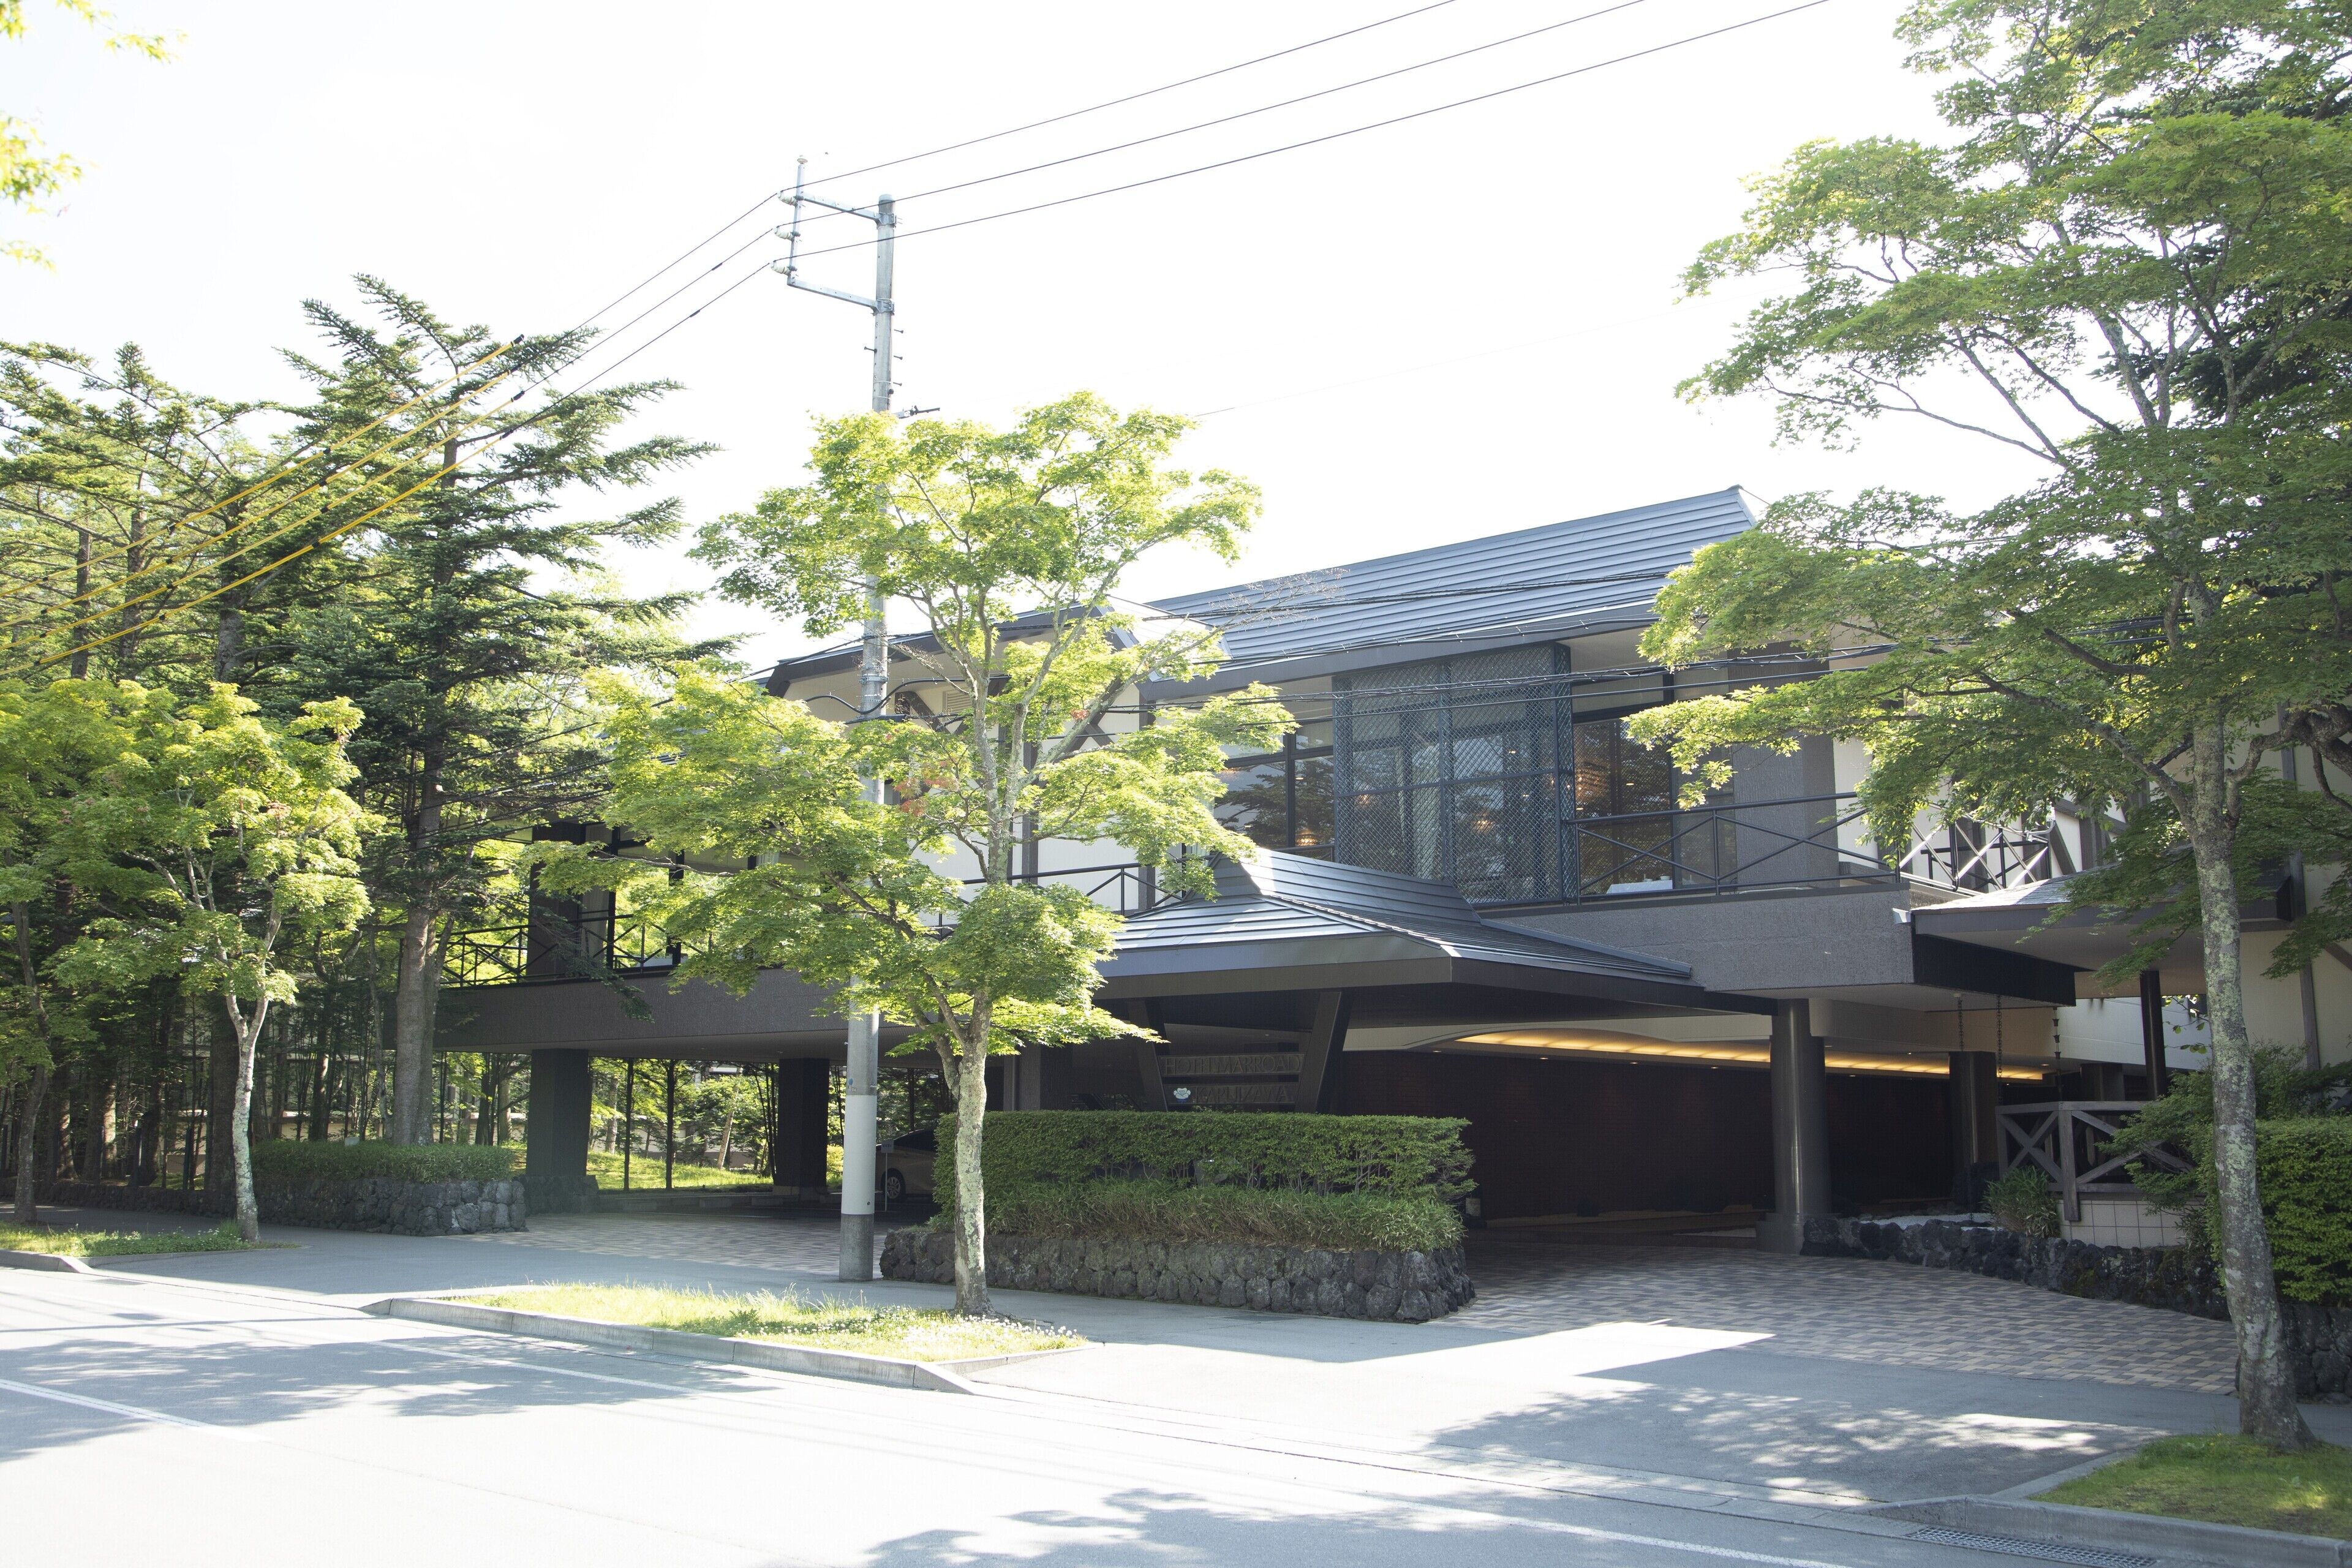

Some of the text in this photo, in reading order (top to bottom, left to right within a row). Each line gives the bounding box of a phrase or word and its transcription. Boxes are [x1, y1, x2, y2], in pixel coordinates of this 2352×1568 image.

[1165, 1055, 1300, 1074] HOTEL MARROAD
[1196, 1085, 1288, 1103] KARUIZAWA
